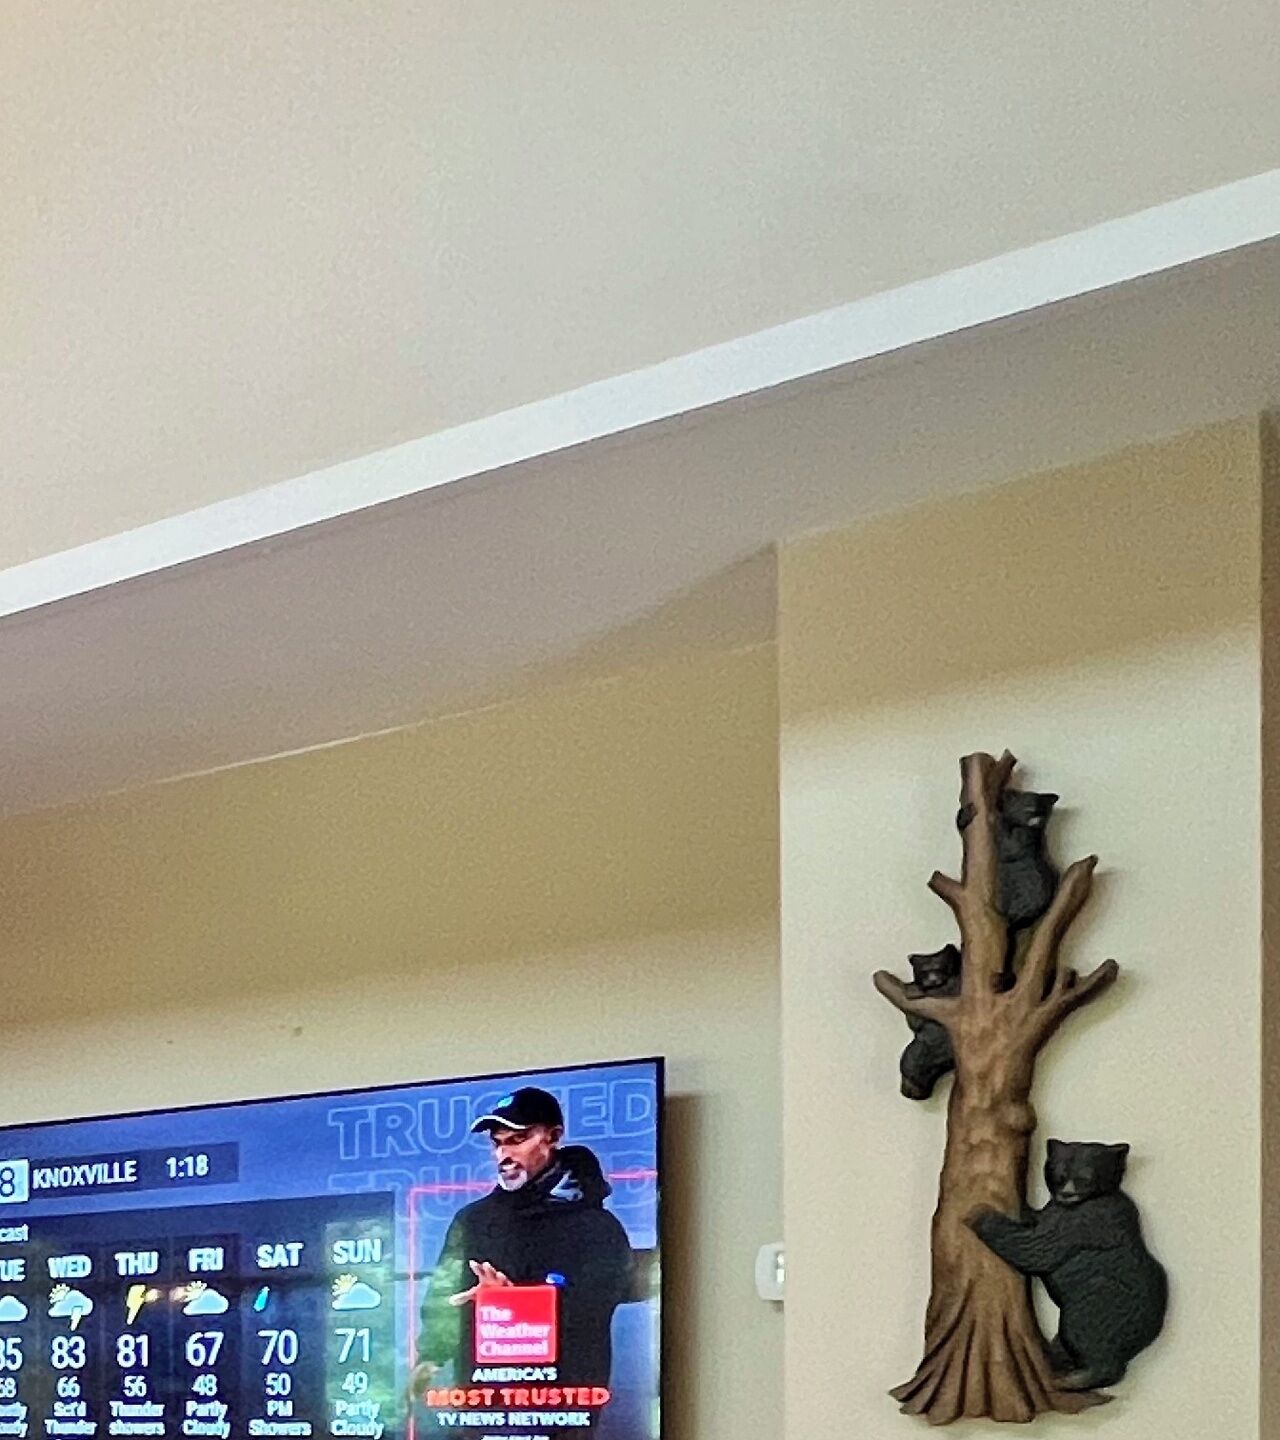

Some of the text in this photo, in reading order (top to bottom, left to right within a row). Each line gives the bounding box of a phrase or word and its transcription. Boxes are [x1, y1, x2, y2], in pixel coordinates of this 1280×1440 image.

[328, 1079, 655, 1160] TRUED
[33, 1154, 209, 1190] KNOXVILLE 1:18
[47, 1254, 92, 1279] WED
[114, 1250, 159, 1276] THU
[188, 1247, 224, 1272] FRI
[256, 1242, 304, 1269] SAT
[332, 1238, 382, 1265] SUN
[479, 1305, 513, 1323] The
[479, 1322, 551, 1340] Weather
[51, 1335, 86, 1370] 83
[116, 1334, 149, 1368] 81
[185, 1331, 224, 1367] 67
[257, 1328, 298, 1366] 70
[334, 1327, 371, 1364] 71
[479, 1340, 550, 1357] Channel
[57, 1376, 80, 1398] 66
[123, 1375, 147, 1397] 56
[191, 1373, 217, 1396] 48
[265, 1372, 291, 1396] 50
[341, 1371, 368, 1394] 49
[472, 1367, 557, 1382] AMERICA'S
[426, 1386, 611, 1407] MOST TRUSTED
[185, 1400, 228, 1419] Partly
[266, 1400, 294, 1417] PM
[335, 1400, 380, 1418] Partly
[183, 1419, 231, 1440] Cloudy
[330, 1418, 385, 1440] Cloudy
[435, 1412, 590, 1427] TV NEWS NETWORK
